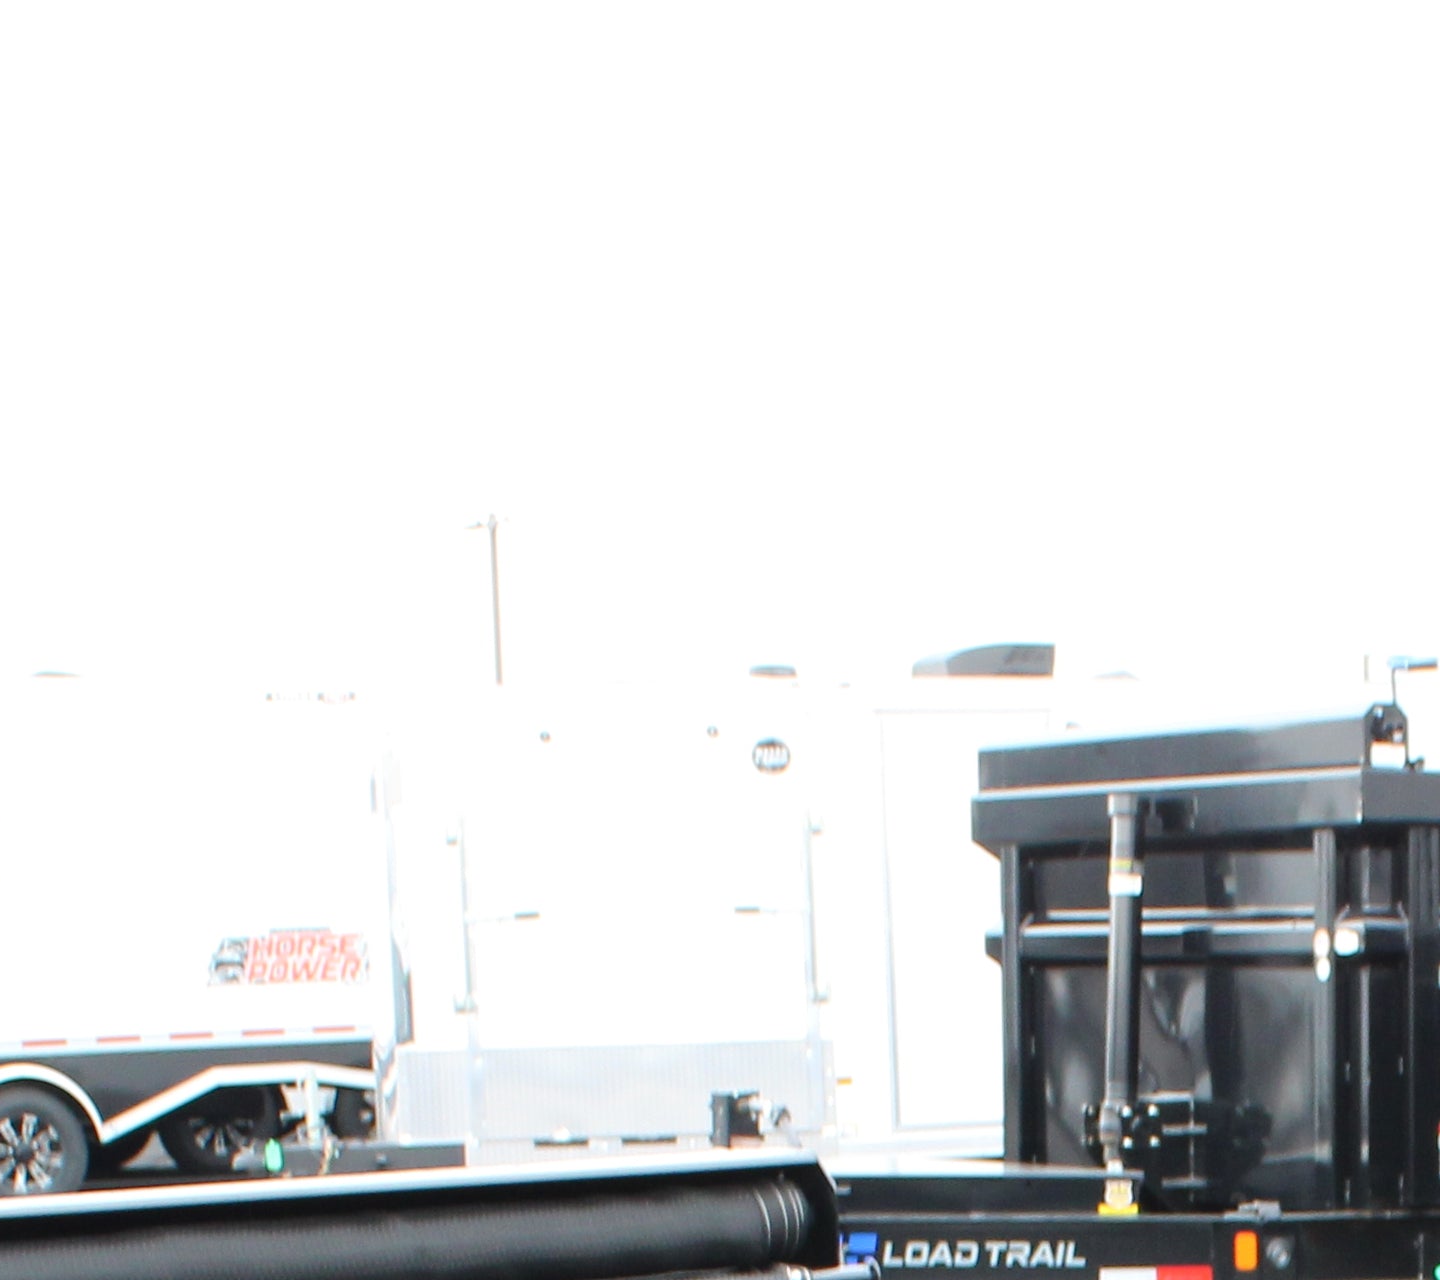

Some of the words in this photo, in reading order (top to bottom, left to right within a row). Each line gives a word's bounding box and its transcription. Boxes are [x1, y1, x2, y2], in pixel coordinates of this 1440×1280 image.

[250, 934, 359, 958] HORSE
[247, 956, 362, 984] POWER
[882, 1240, 979, 1268] LOAD
[985, 1240, 1087, 1268] TRAIL
